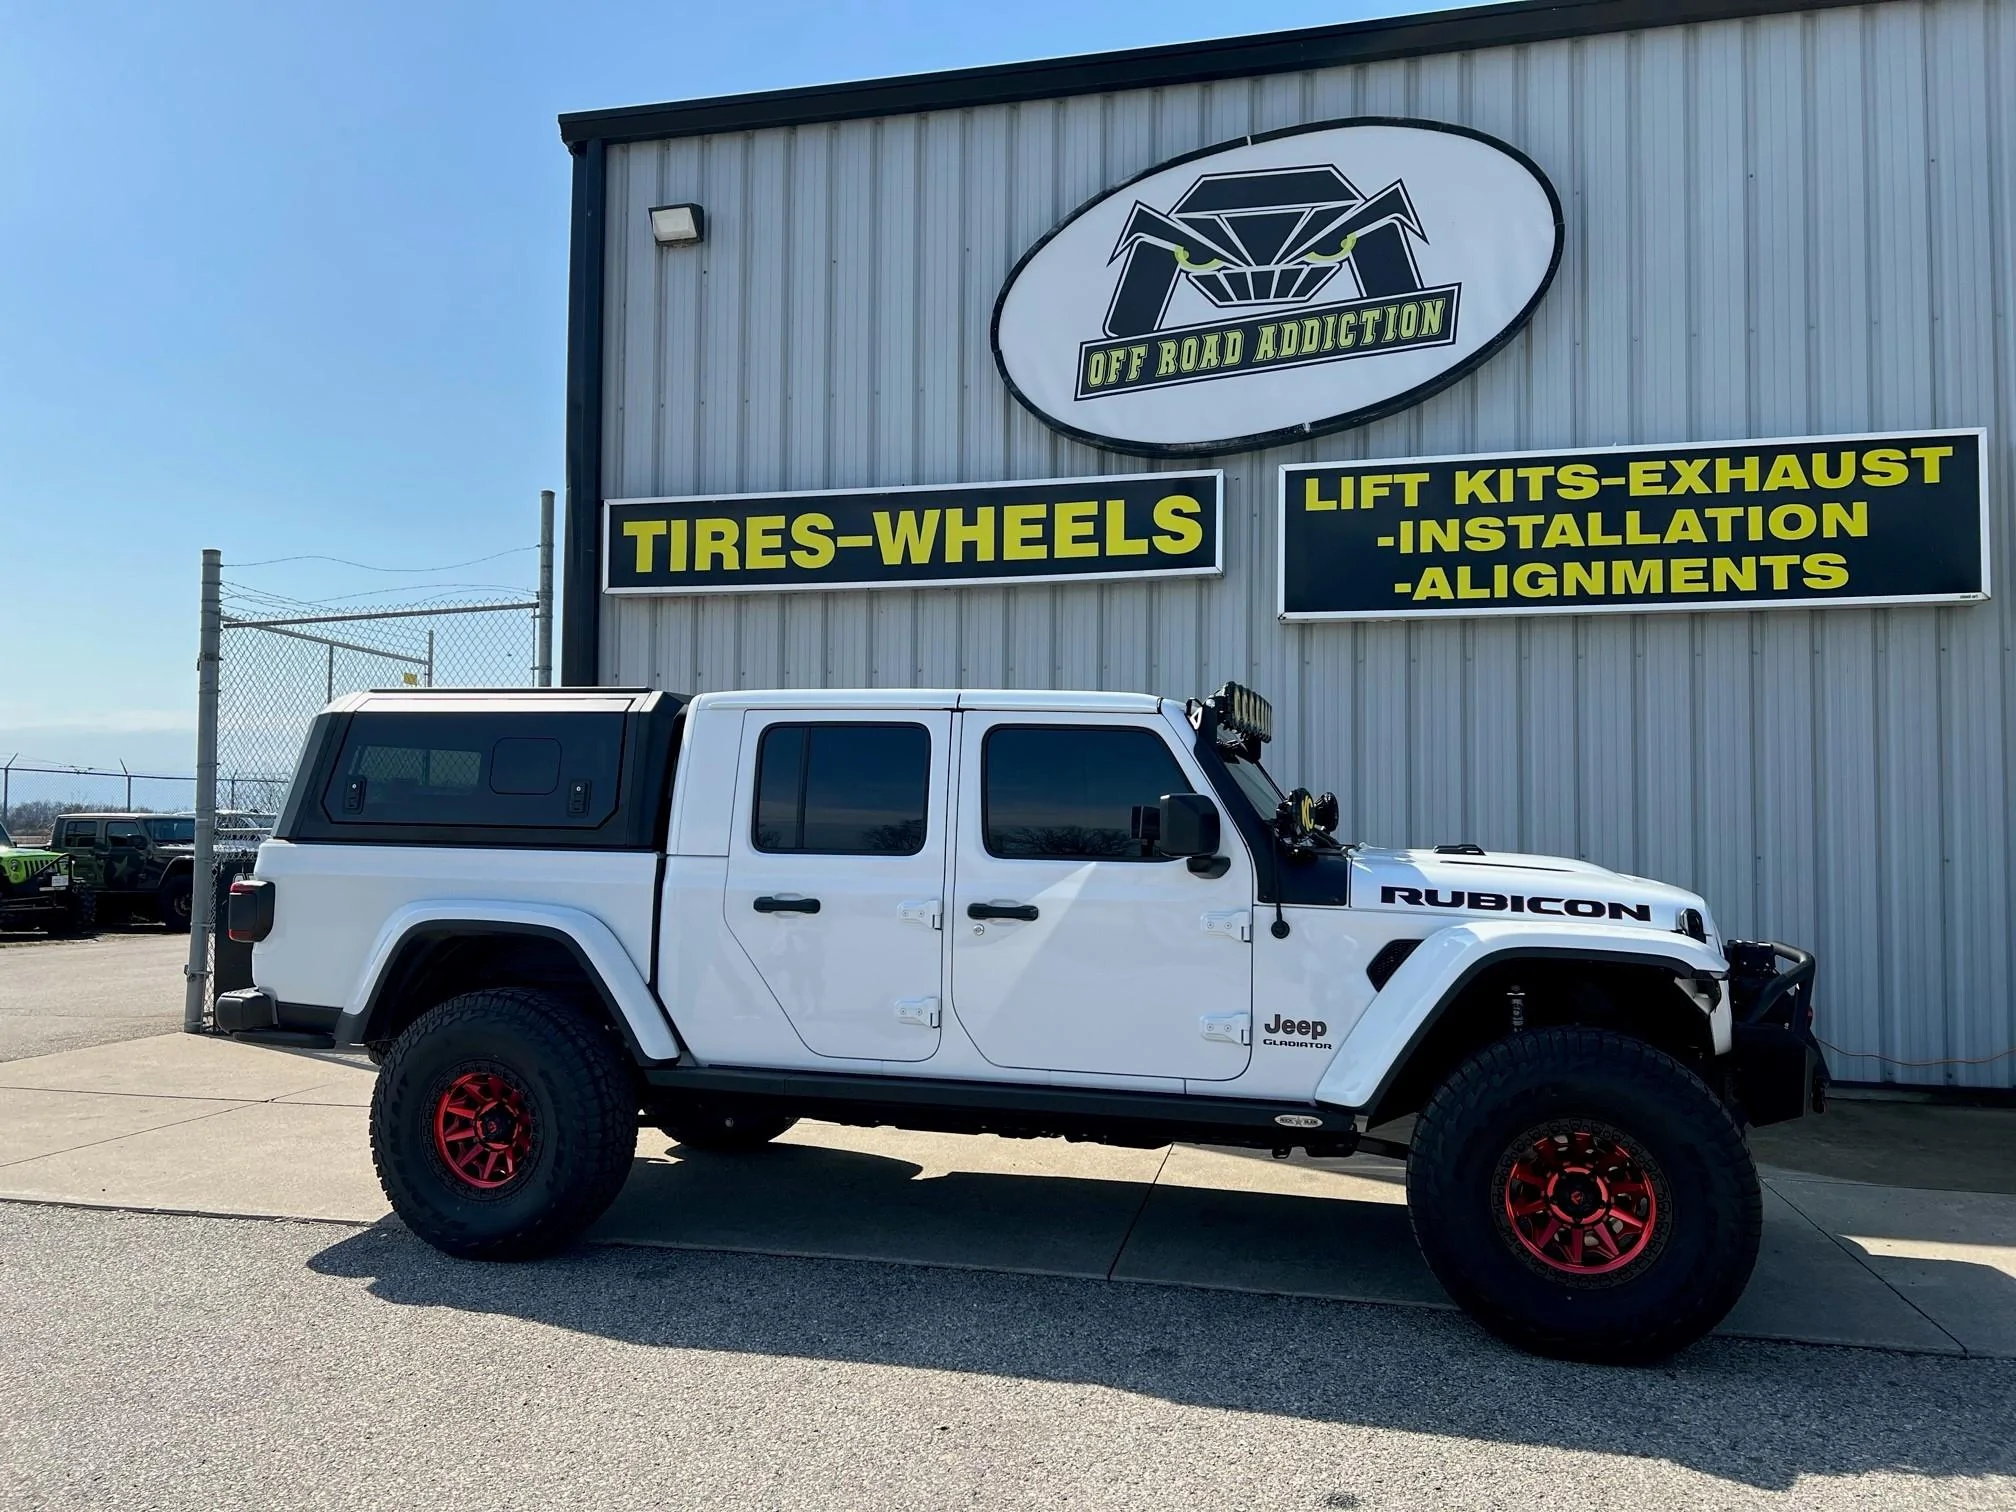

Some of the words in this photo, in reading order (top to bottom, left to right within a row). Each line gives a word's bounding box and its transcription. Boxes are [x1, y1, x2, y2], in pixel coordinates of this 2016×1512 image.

[1087, 344, 1149, 388] OFF
[1154, 329, 1244, 378] ROAD
[1252, 297, 1447, 362] ADDICTION
[1305, 472, 1430, 512] LIFT
[1454, 445, 1954, 505] KITS-EXHAUST
[623, 494, 1203, 573] TIRES-WHEELS
[1377, 501, 1868, 554] -INSTALLATION
[1394, 552, 1849, 601] -ALIGNMENTS
[1301, 795, 1315, 832] KC
[1380, 885, 1651, 922] RUBICON
[1262, 1038, 1333, 1050] GLADIATOR
[1264, 1013, 1327, 1041] Jeep
